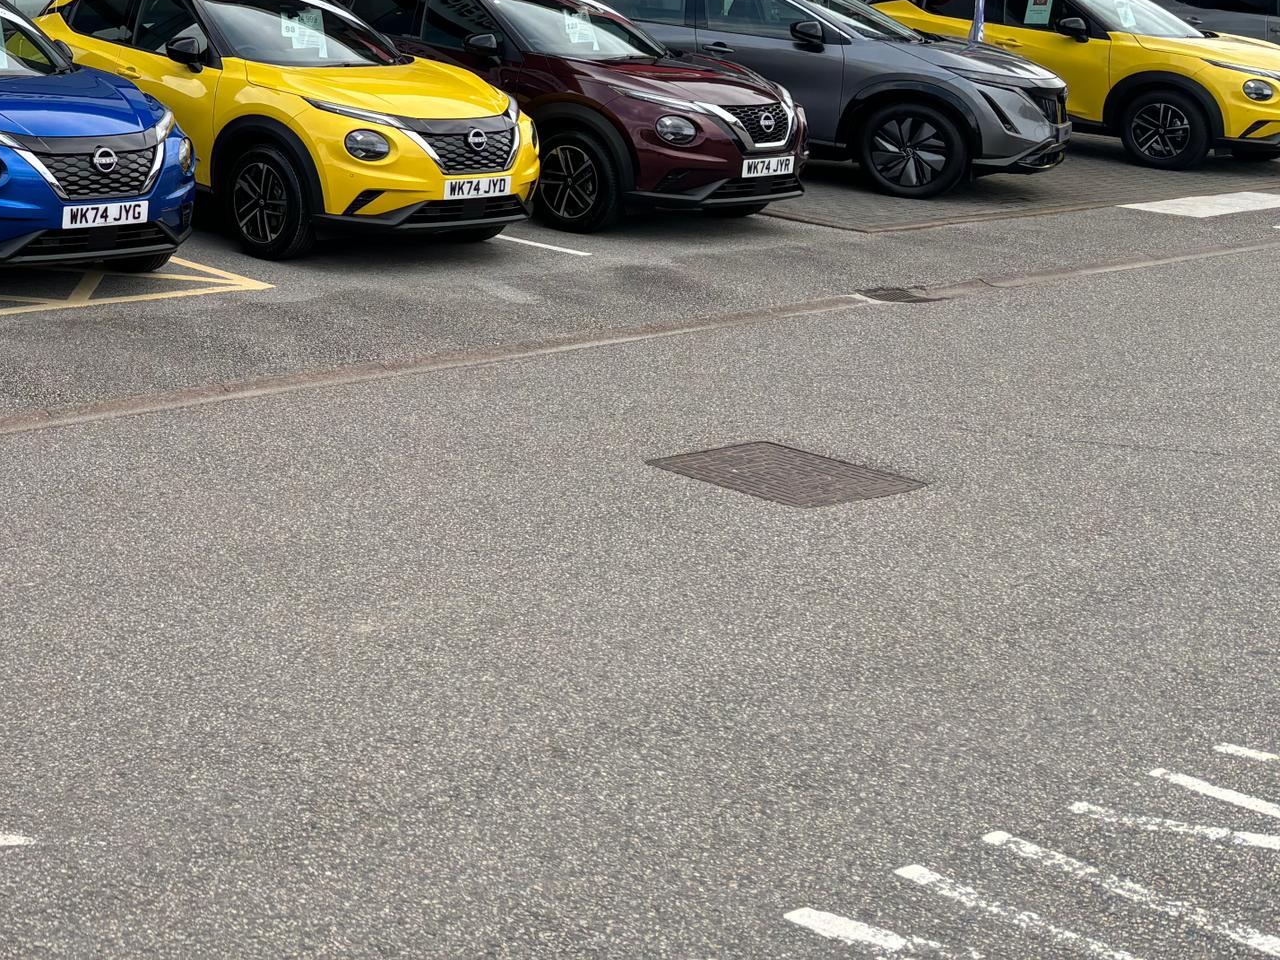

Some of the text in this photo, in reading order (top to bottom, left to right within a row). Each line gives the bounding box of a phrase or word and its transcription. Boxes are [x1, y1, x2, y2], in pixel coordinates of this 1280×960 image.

[746, 158, 791, 175] WK74 JYR
[449, 178, 506, 197] WK74 JYD
[70, 204, 141, 225] WK74 JYG
